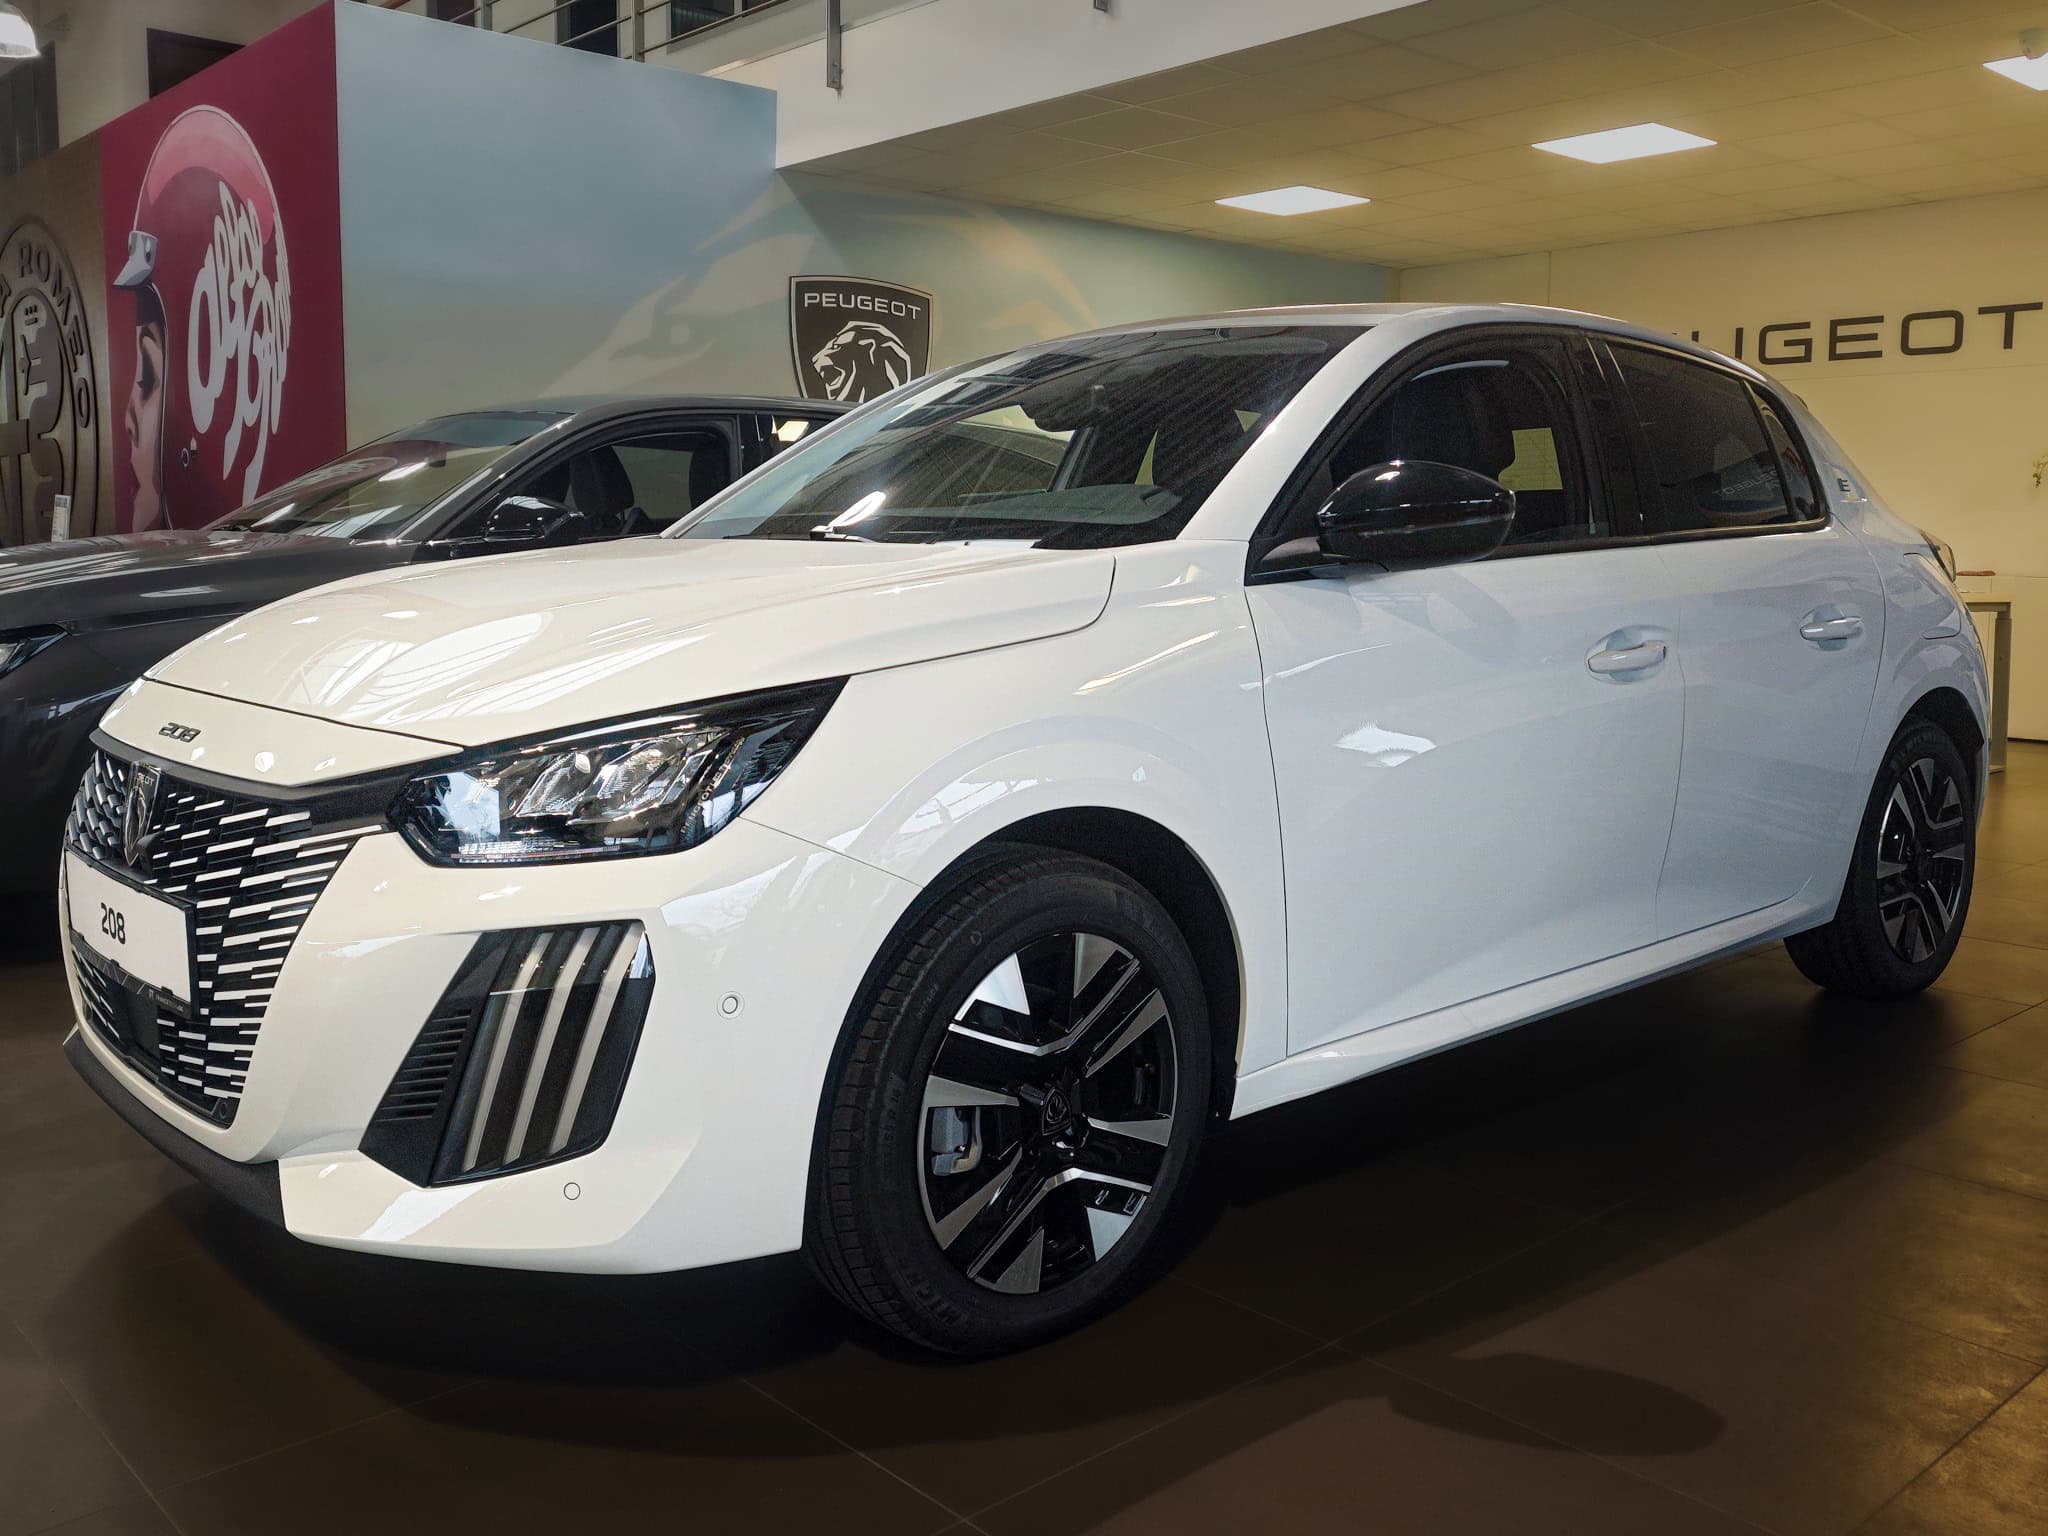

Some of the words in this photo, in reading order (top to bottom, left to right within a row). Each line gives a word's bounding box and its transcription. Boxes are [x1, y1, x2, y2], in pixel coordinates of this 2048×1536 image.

[804, 292, 921, 319] PEUGEOT
[18, 242, 90, 428] ROMEO
[158, 722, 201, 743] 208
[100, 902, 126, 945] 208
